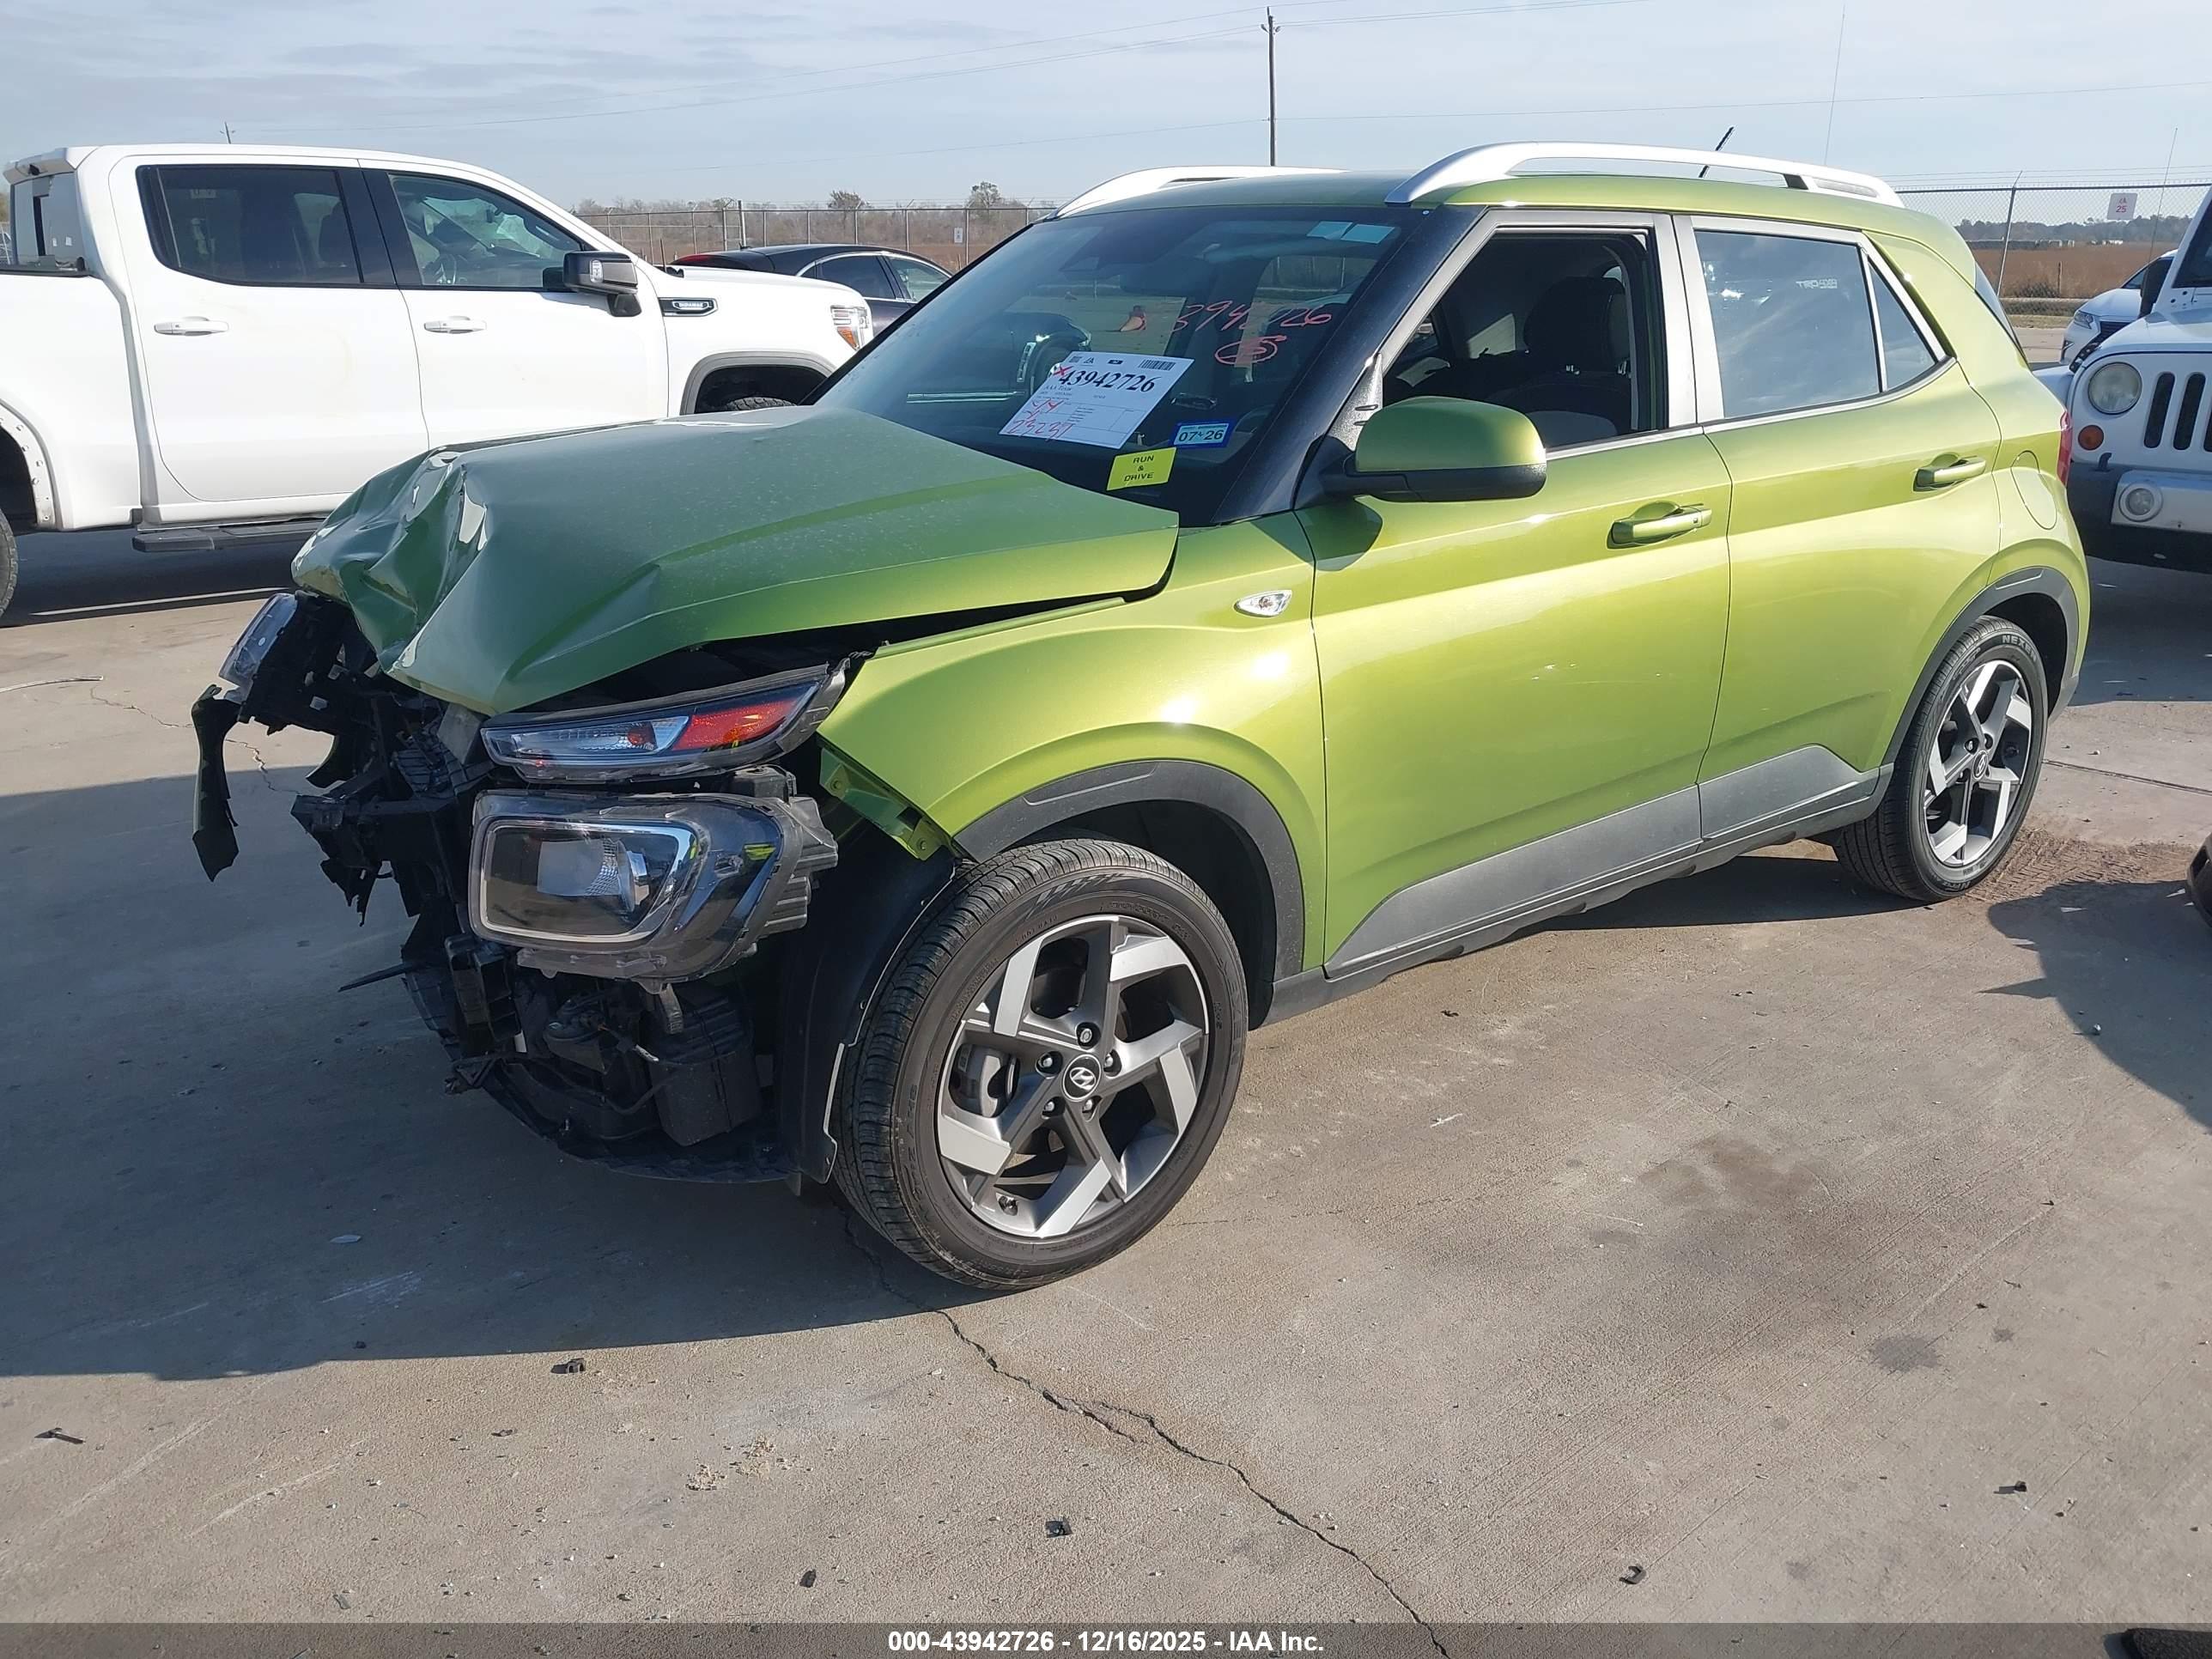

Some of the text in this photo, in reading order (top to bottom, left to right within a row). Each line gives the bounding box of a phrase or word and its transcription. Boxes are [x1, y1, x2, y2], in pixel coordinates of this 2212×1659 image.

[1058, 369, 1162, 392] 43942726
[1178, 429, 1224, 442] 07 26
[1133, 455, 1155, 465] RUN
[1123, 471, 1155, 483] DRIVE
[2001, 635, 2038, 662] NEXEN
